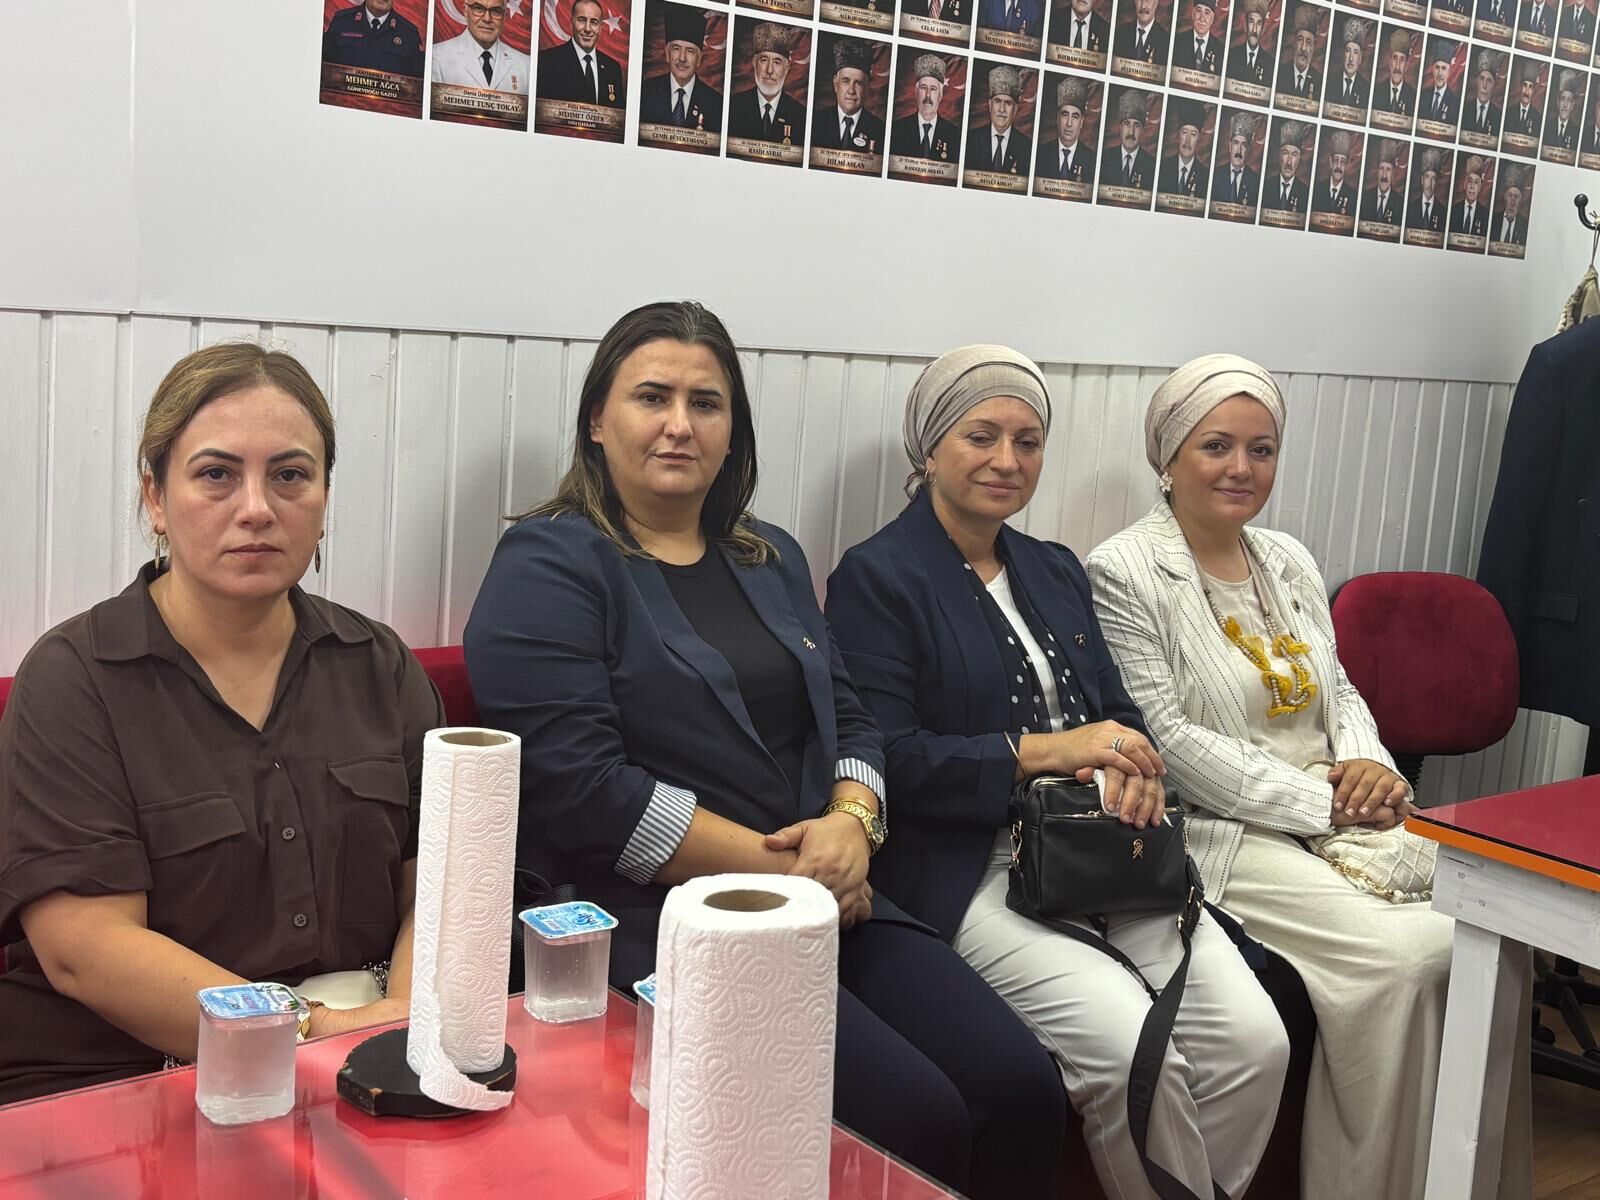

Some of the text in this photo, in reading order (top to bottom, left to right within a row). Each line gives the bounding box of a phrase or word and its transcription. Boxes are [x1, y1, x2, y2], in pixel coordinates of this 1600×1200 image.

[345, 75, 400, 92] MEHMET AĞCA
[443, 96, 520, 113] MEHMET TUNÇ TOKAY
[558, 110, 584, 120] MEHMET
